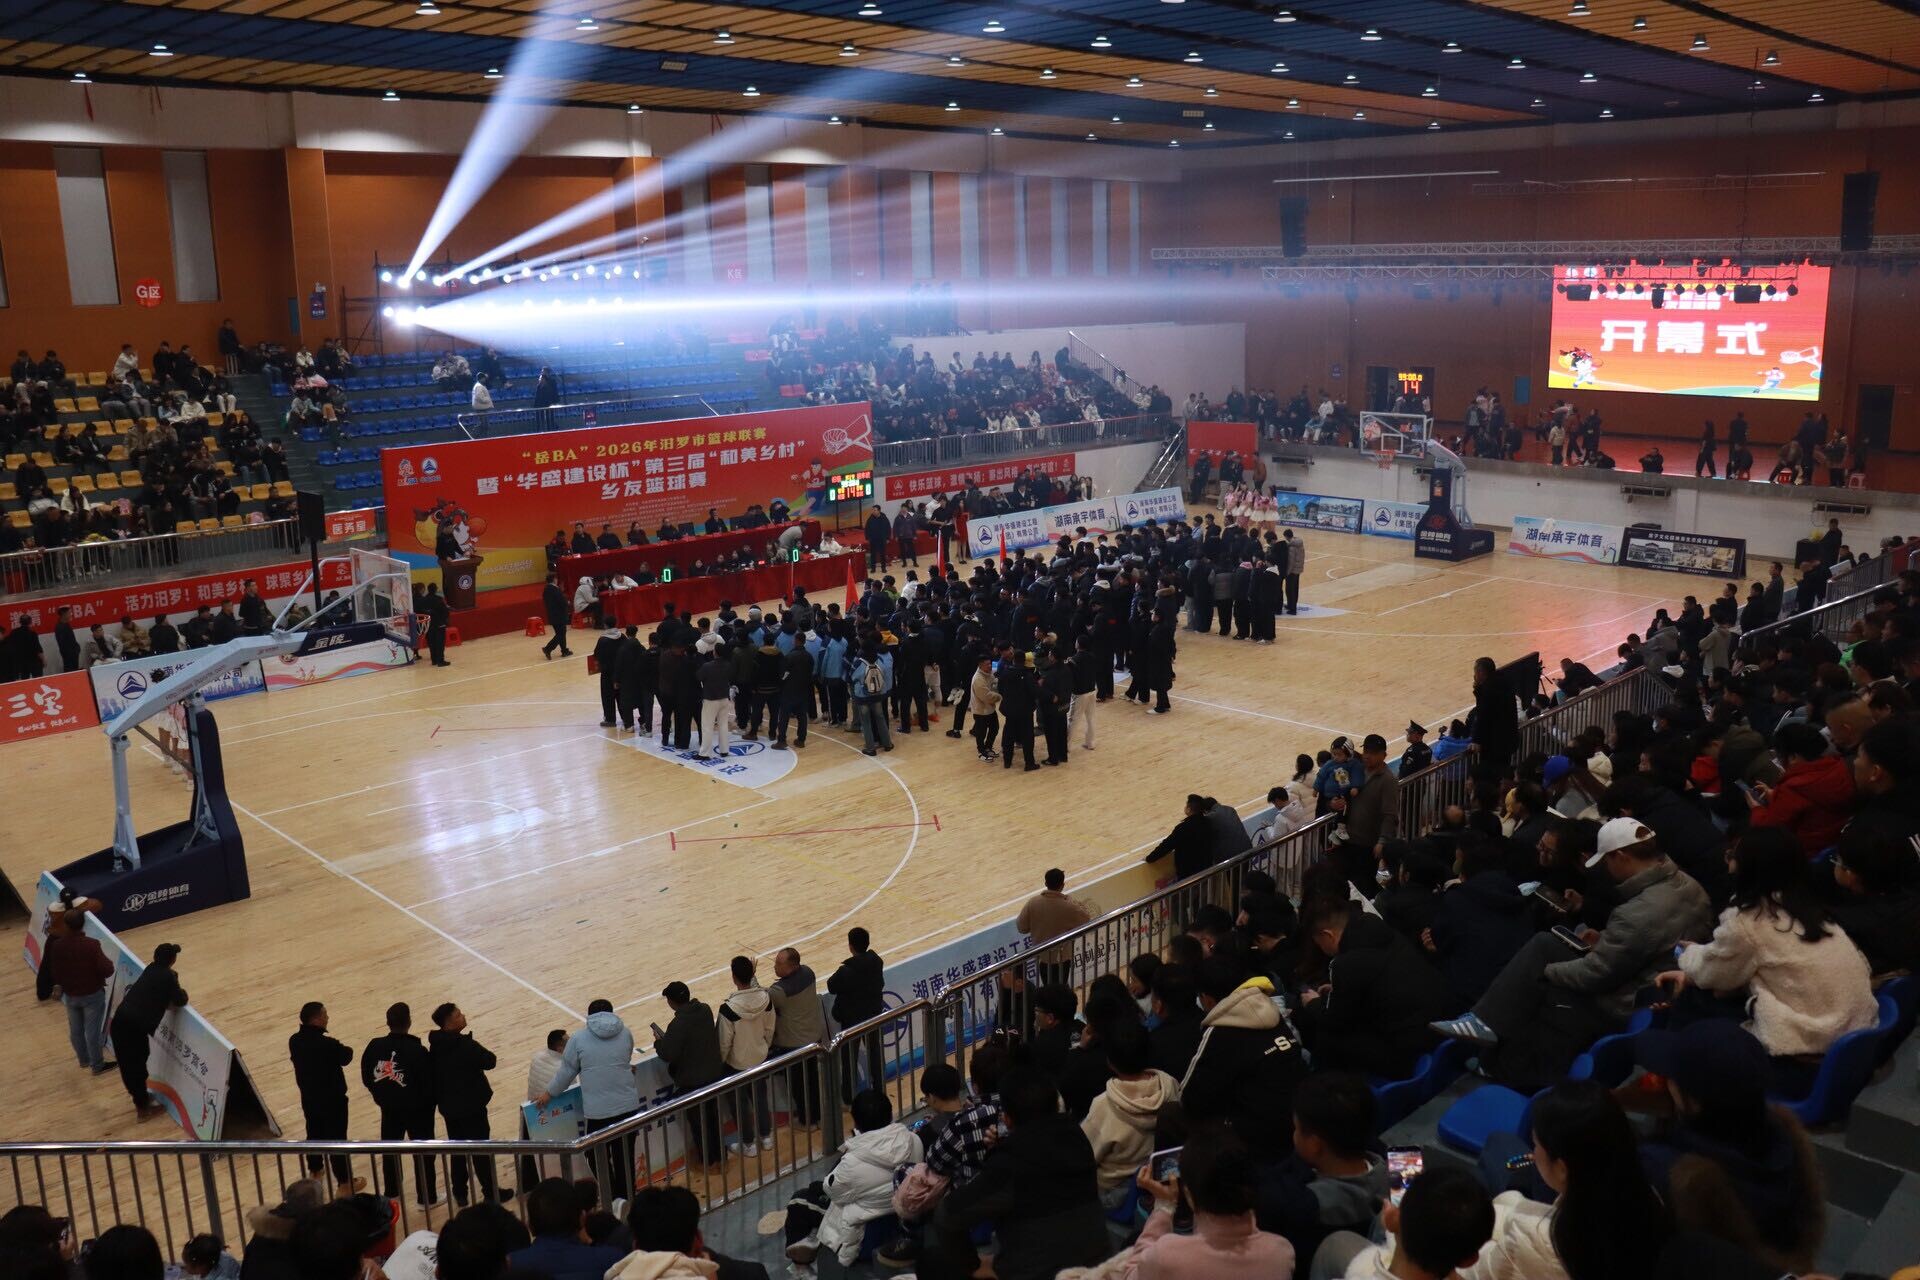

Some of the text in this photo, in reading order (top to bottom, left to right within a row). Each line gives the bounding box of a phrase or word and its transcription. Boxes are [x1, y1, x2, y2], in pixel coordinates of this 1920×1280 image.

[136, 284, 161, 299] G区
[1599, 319, 1768, 356] 开幕式
[1404, 381, 1419, 395] 14
[601, 471, 707, 500] 乡友篮球赛
[1054, 508, 1106, 528] 湖南承宇体育
[1526, 528, 1603, 548] 湖南承宇体育
[792, 549, 799, 563] 0
[663, 568, 672, 583] 0
